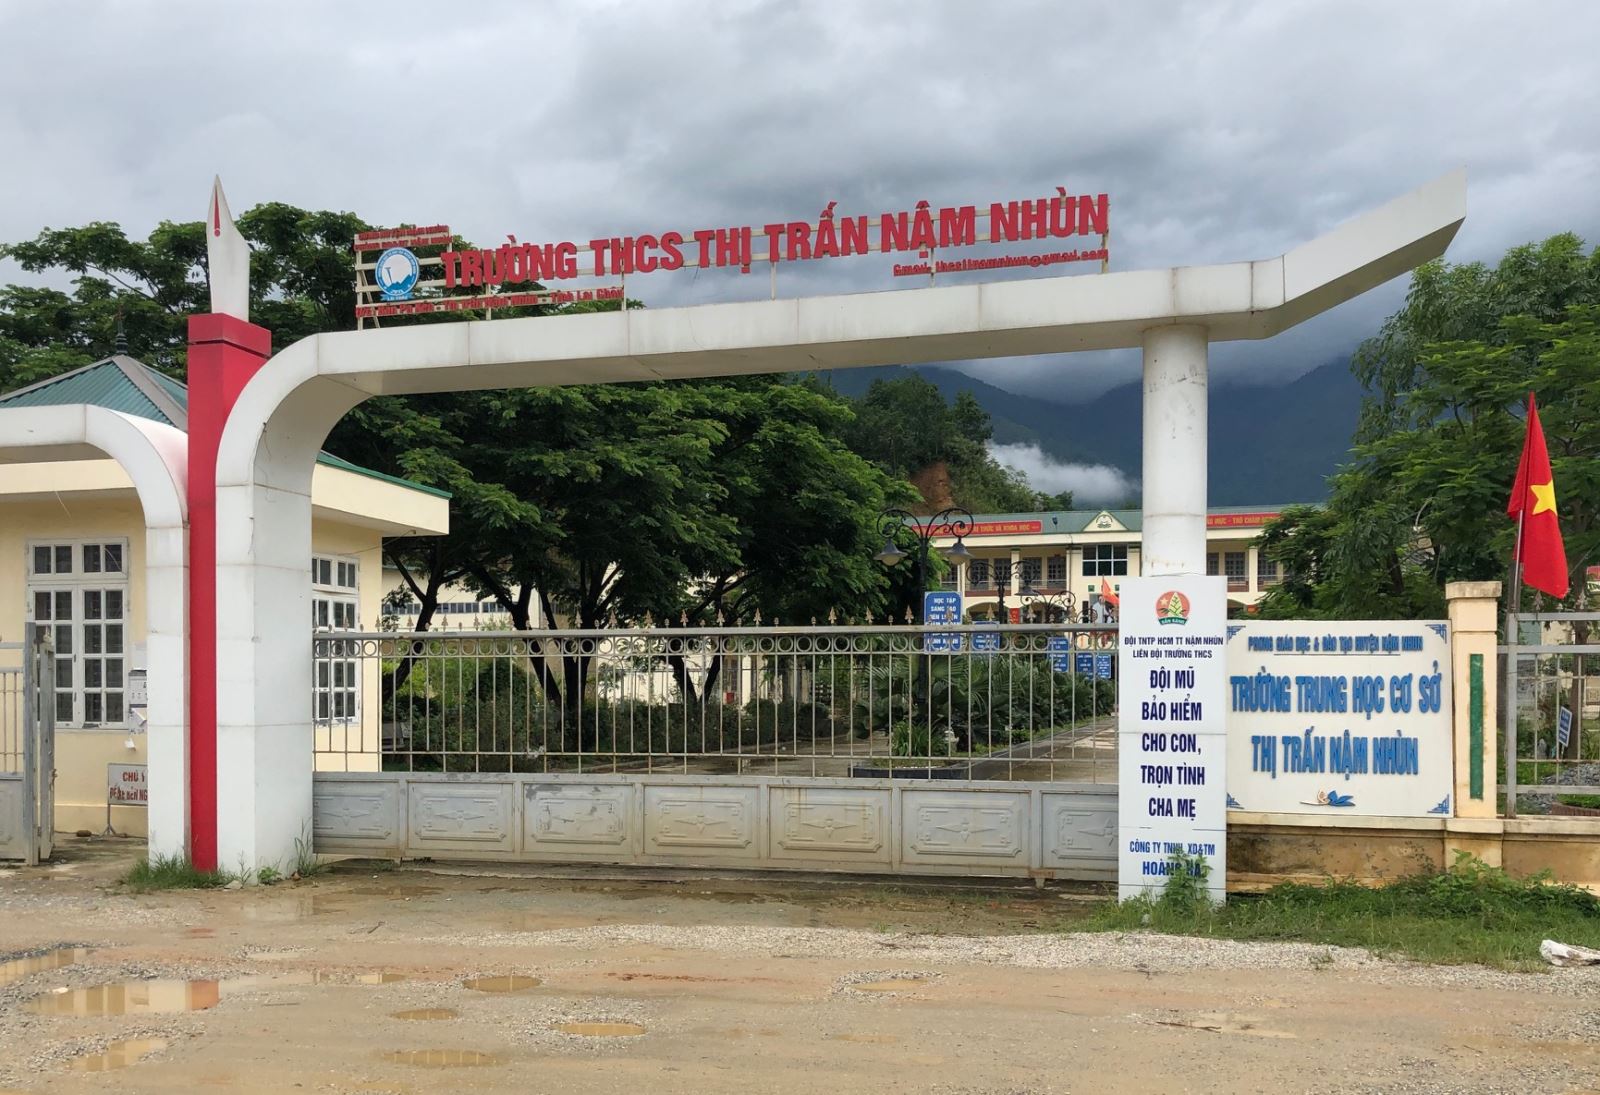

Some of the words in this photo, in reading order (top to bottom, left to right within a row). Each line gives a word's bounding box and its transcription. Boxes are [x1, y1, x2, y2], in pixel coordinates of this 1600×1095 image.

[441, 235, 577, 288] TRƯỜNG
[590, 231, 684, 277] THCS
[693, 226, 752, 274] THỊ
[764, 202, 868, 263] TRẤN
[880, 200, 975, 259] NẬM
[990, 186, 1108, 244] NHÙN
[1132, 648, 1149, 658] LIÊN
[1194, 649, 1212, 658] THCS
[1139, 636, 1155, 645] TNTP
[1157, 636, 1173, 645] HCM
[1176, 636, 1183, 645] TT
[1355, 633, 1380, 654] HUYỆN
[1150, 666, 1171, 692] ĐỘI
[1175, 666, 1195, 689] MŨ
[1230, 666, 1292, 713] TRƯỜNG
[1295, 675, 1347, 713] TRUNG
[1352, 675, 1385, 720] HỌC
[1389, 673, 1413, 713] CƠ
[1418, 660, 1442, 713] SỞ
[1142, 694, 1166, 721] BẢO
[1170, 693, 1202, 721] HIỂM
[1142, 733, 1166, 752] CHO
[1170, 733, 1201, 755] CON,
[1251, 735, 1277, 779] THỊ
[1281, 725, 1326, 774] TRẤN
[1329, 729, 1368, 780] NẬM
[1372, 729, 1419, 775] NHÙN
[1140, 765, 1173, 788] TRỌN
[1177, 762, 1205, 785] TÌNH
[1148, 797, 1173, 817] CHA
[1177, 798, 1196, 821] MẸ
[1129, 838, 1150, 853] CÔNG
[1152, 842, 1161, 853] TY
